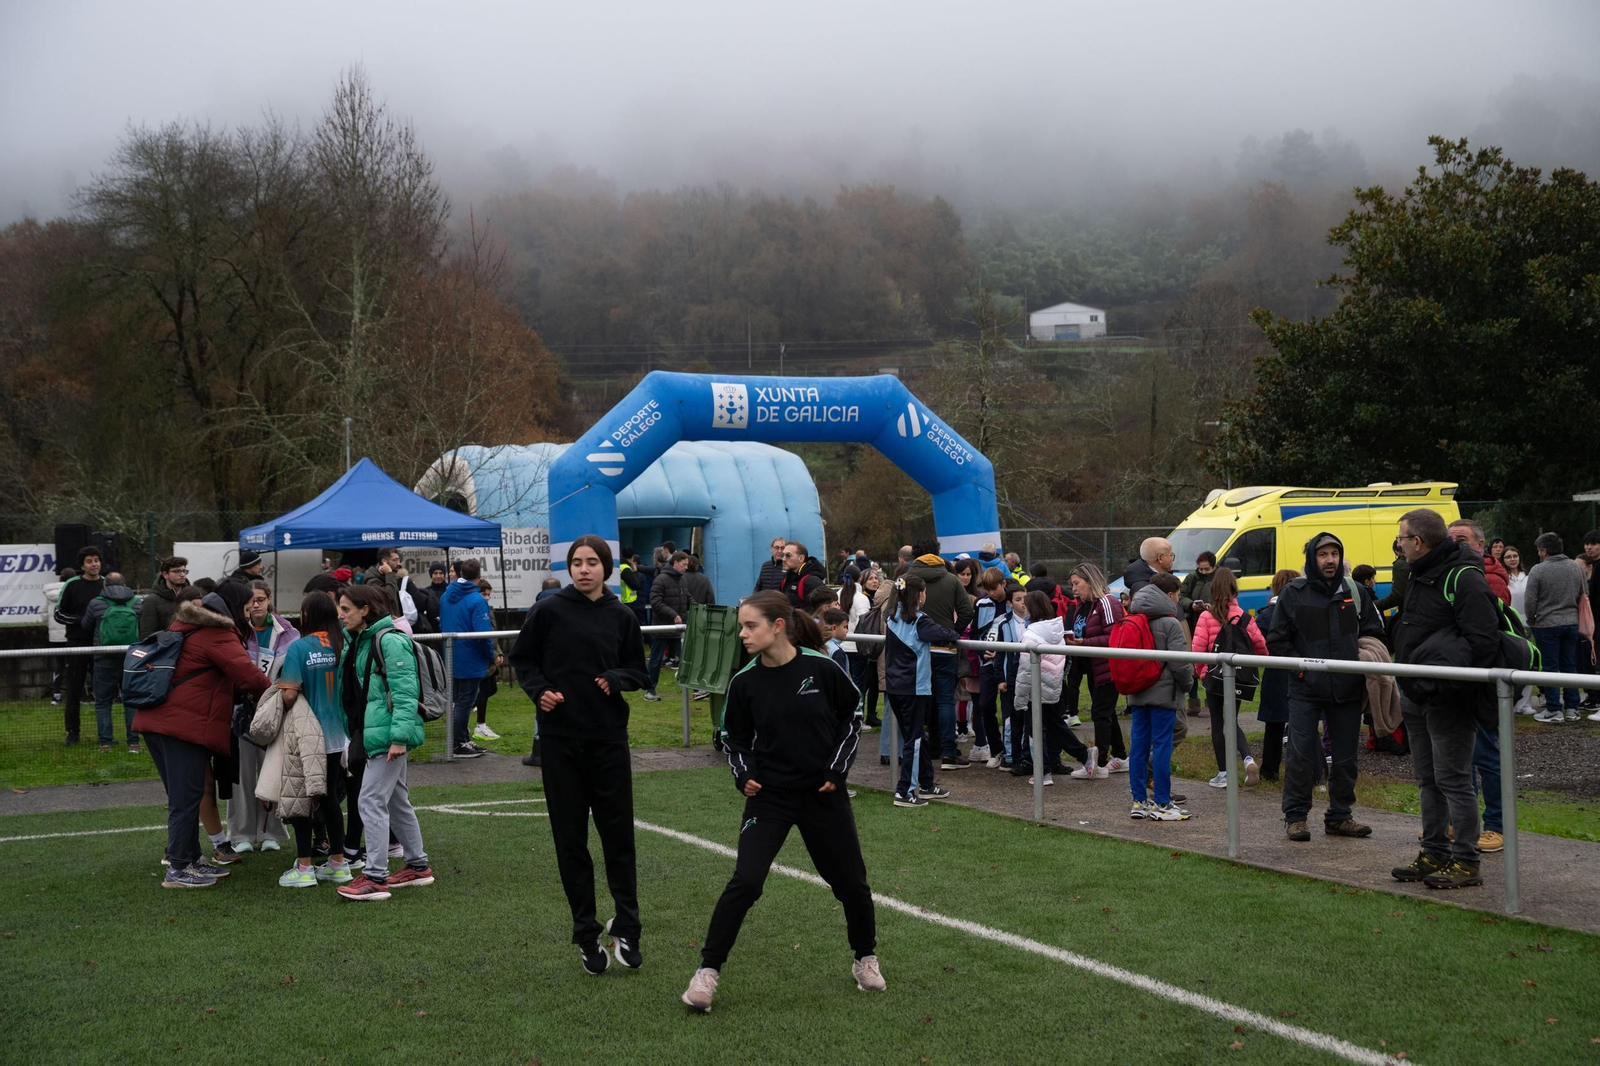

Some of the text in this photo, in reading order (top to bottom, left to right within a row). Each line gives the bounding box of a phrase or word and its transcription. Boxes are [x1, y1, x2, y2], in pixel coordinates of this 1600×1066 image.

[755, 387, 820, 402] XUNTA
[611, 399, 659, 441] DEPORTE
[621, 411, 662, 447] GALEGO
[756, 406, 859, 422] DE GALICIA
[926, 430, 965, 465] GALEGO
[931, 423, 973, 462] DEPORTE
[361, 532, 438, 541] OURENSE ATLETISMO
